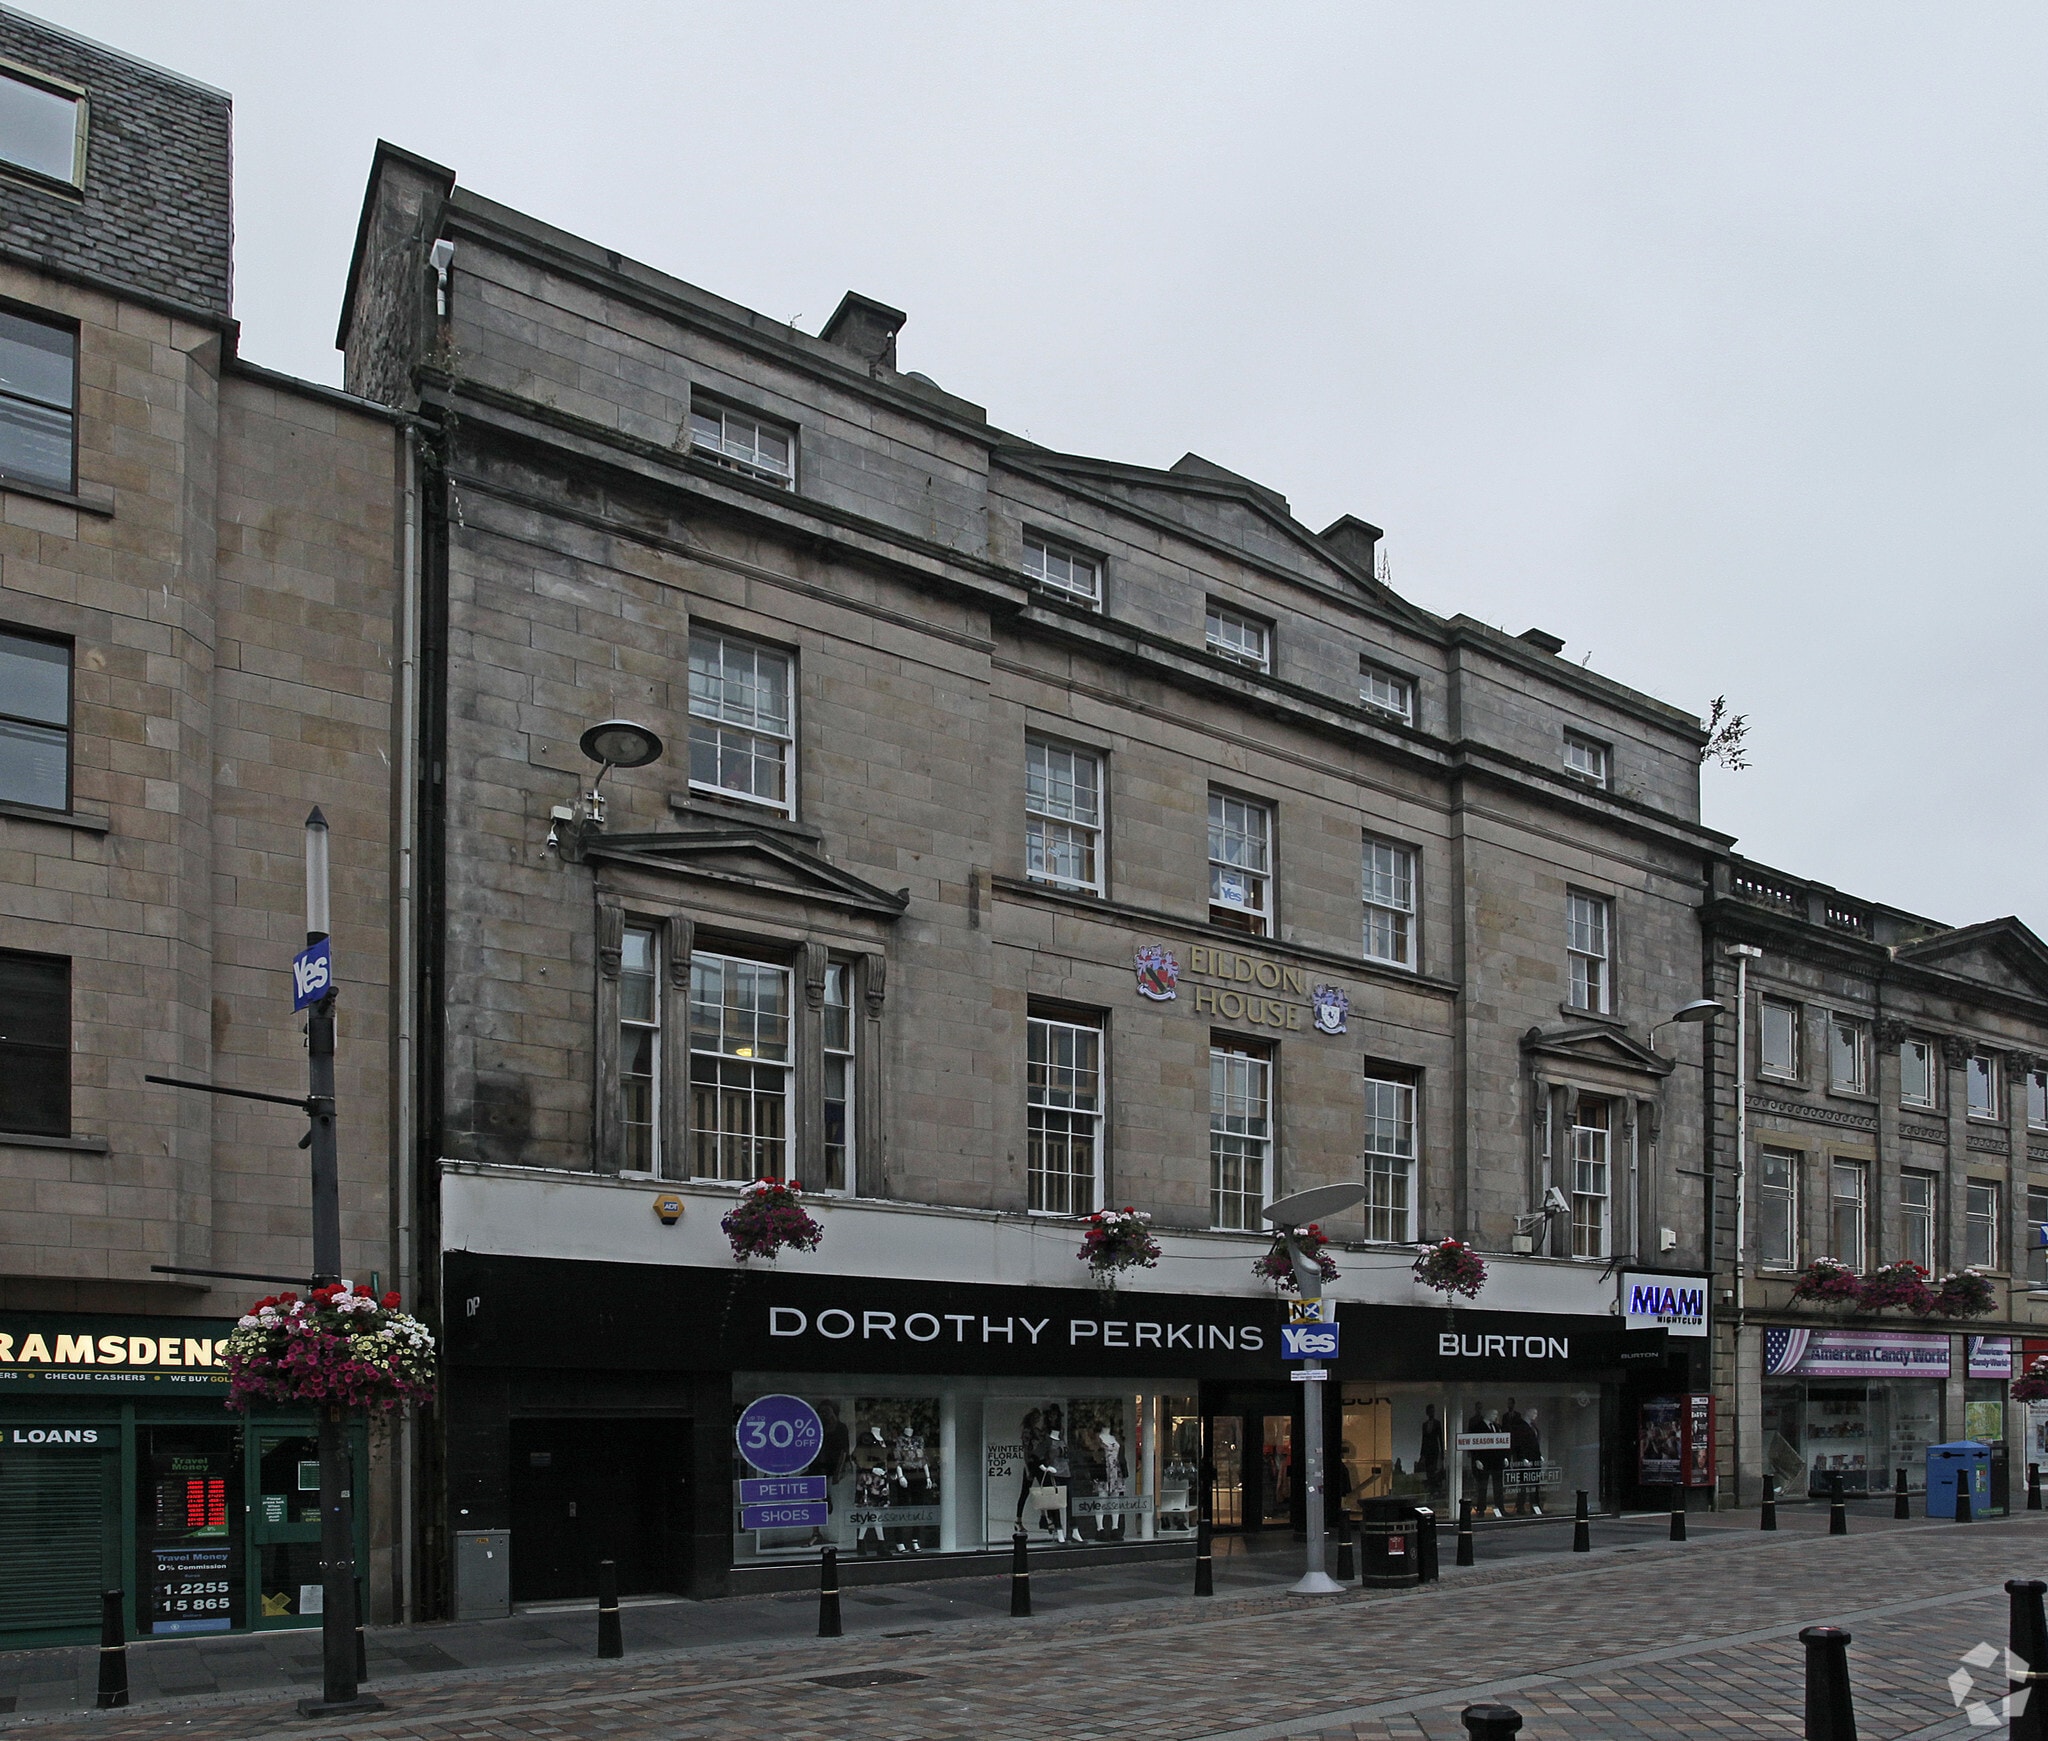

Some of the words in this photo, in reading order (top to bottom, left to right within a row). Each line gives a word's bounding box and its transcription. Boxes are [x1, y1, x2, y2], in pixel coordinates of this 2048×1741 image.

[1221, 887, 1242, 902] Yes
[293, 955, 328, 999] Yes
[1191, 945, 1304, 995] EILDON
[1195, 985, 1300, 1031] HOUSE
[466, 1296, 480, 1318] DP
[1629, 1285, 1703, 1316] MIAMI
[1657, 1316, 1702, 1325] NIGHTCLUB
[769, 1306, 1050, 1345] DOROTHY
[1070, 1319, 1264, 1351] PERKINS
[1282, 1328, 1336, 1353] Yes
[1439, 1333, 1569, 1359] BURTON
[1810, 1346, 1871, 1361] American
[1873, 1347, 1910, 1366] Candy
[1912, 1348, 1947, 1363] World
[44, 1372, 92, 1381] CHEQUE
[94, 1373, 146, 1382] CASHERS
[188, 1375, 209, 1383] BUY
[13, 1429, 98, 1443] LOANS
[746, 1418, 816, 1449] 30%
[795, 1439, 816, 1447] OFF
[1472, 1437, 1494, 1445] SEASON
[171, 1463, 209, 1471] Money
[988, 1467, 1012, 1477] £24
[1505, 1472, 1521, 1483] THE
[1523, 1471, 1545, 1482] RIGHT
[1548, 1470, 1559, 1481] FIT
[759, 1483, 809, 1496] PETITE
[761, 1509, 810, 1523] SHOES
[192, 1553, 229, 1561] Money
[157, 1563, 175, 1571] 0%
[177, 1563, 227, 1571] Commission
[163, 1581, 230, 1595] 1.2255
